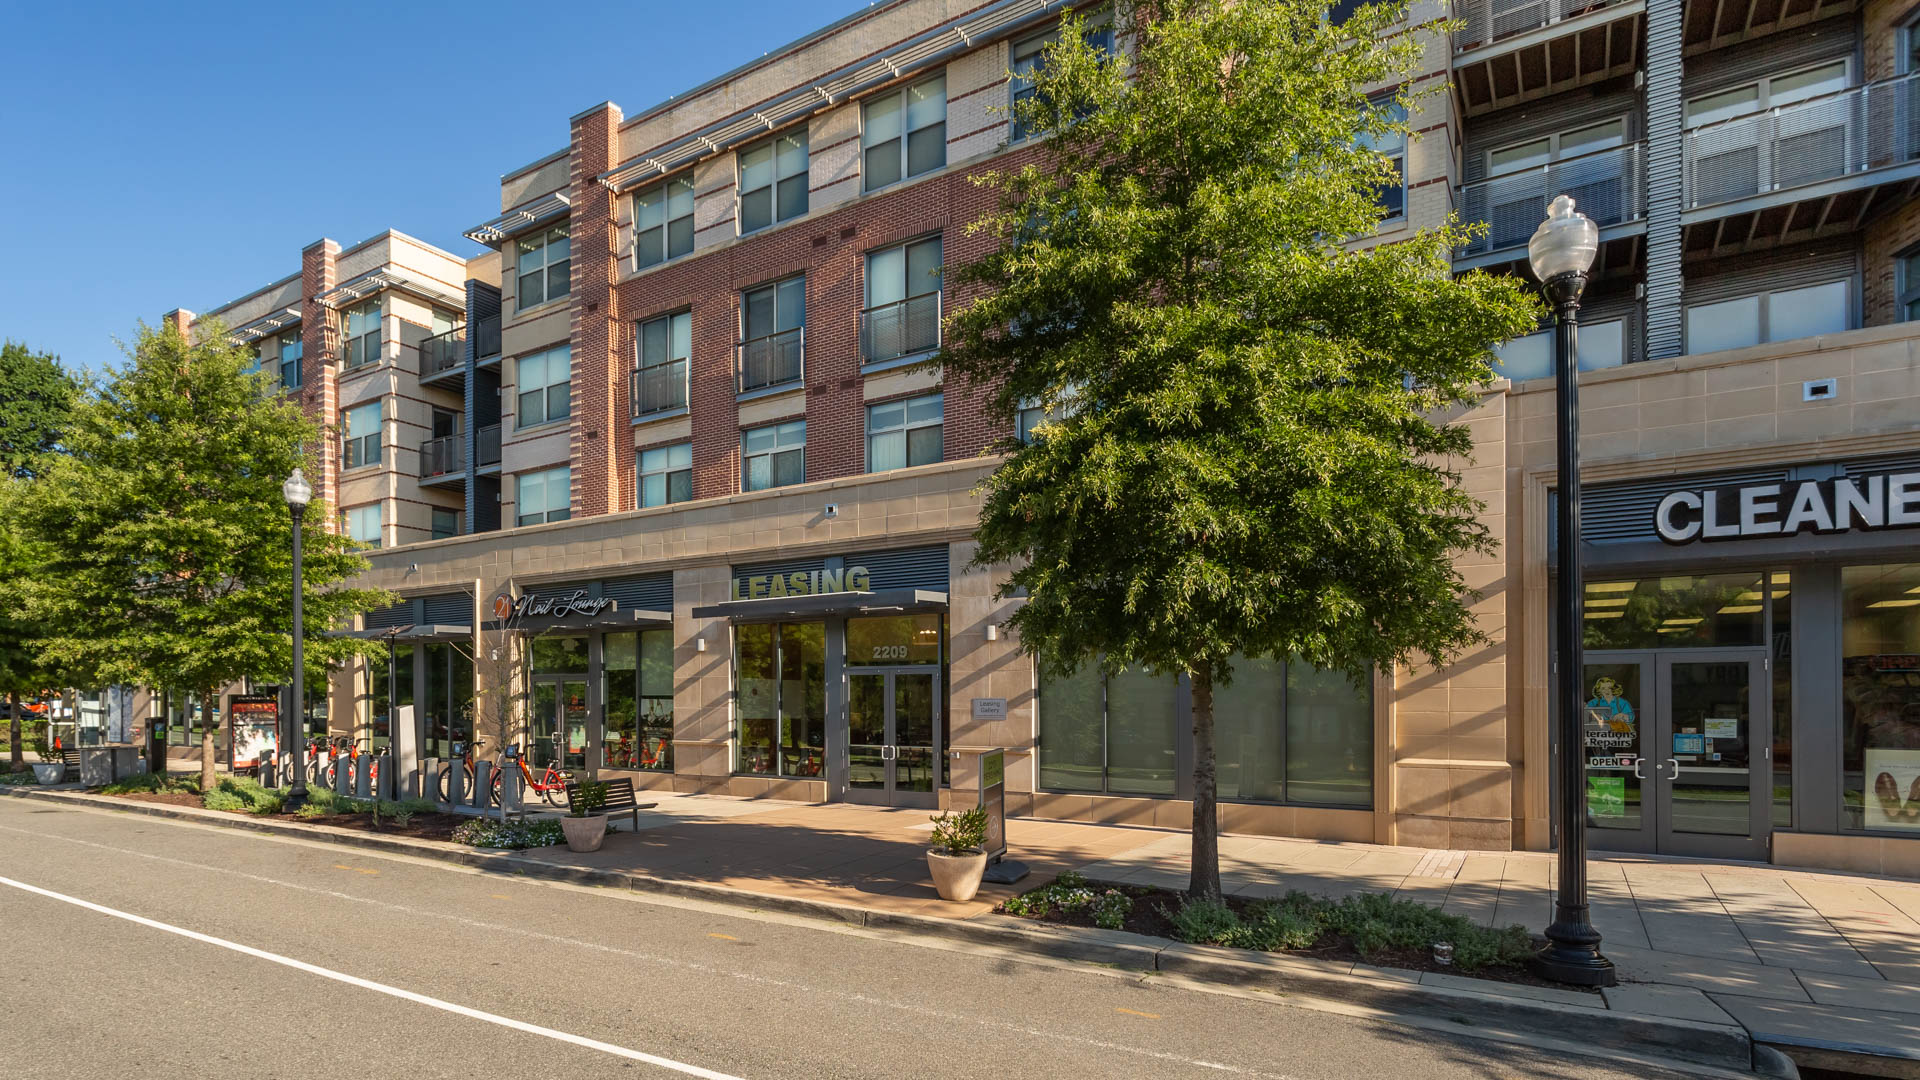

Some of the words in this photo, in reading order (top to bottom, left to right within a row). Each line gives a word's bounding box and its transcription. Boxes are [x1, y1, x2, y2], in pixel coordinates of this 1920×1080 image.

[1656, 471, 1920, 541] CLEANE
[732, 565, 870, 601] LEASING
[496, 596, 510, 618] 21
[516, 595, 554, 616] Nail
[553, 589, 612, 618] Lounge
[872, 645, 908, 659] 2209
[1586, 730, 1636, 739] terations
[1590, 738, 1631, 748] Repairs
[1591, 758, 1619, 766] OPEN
